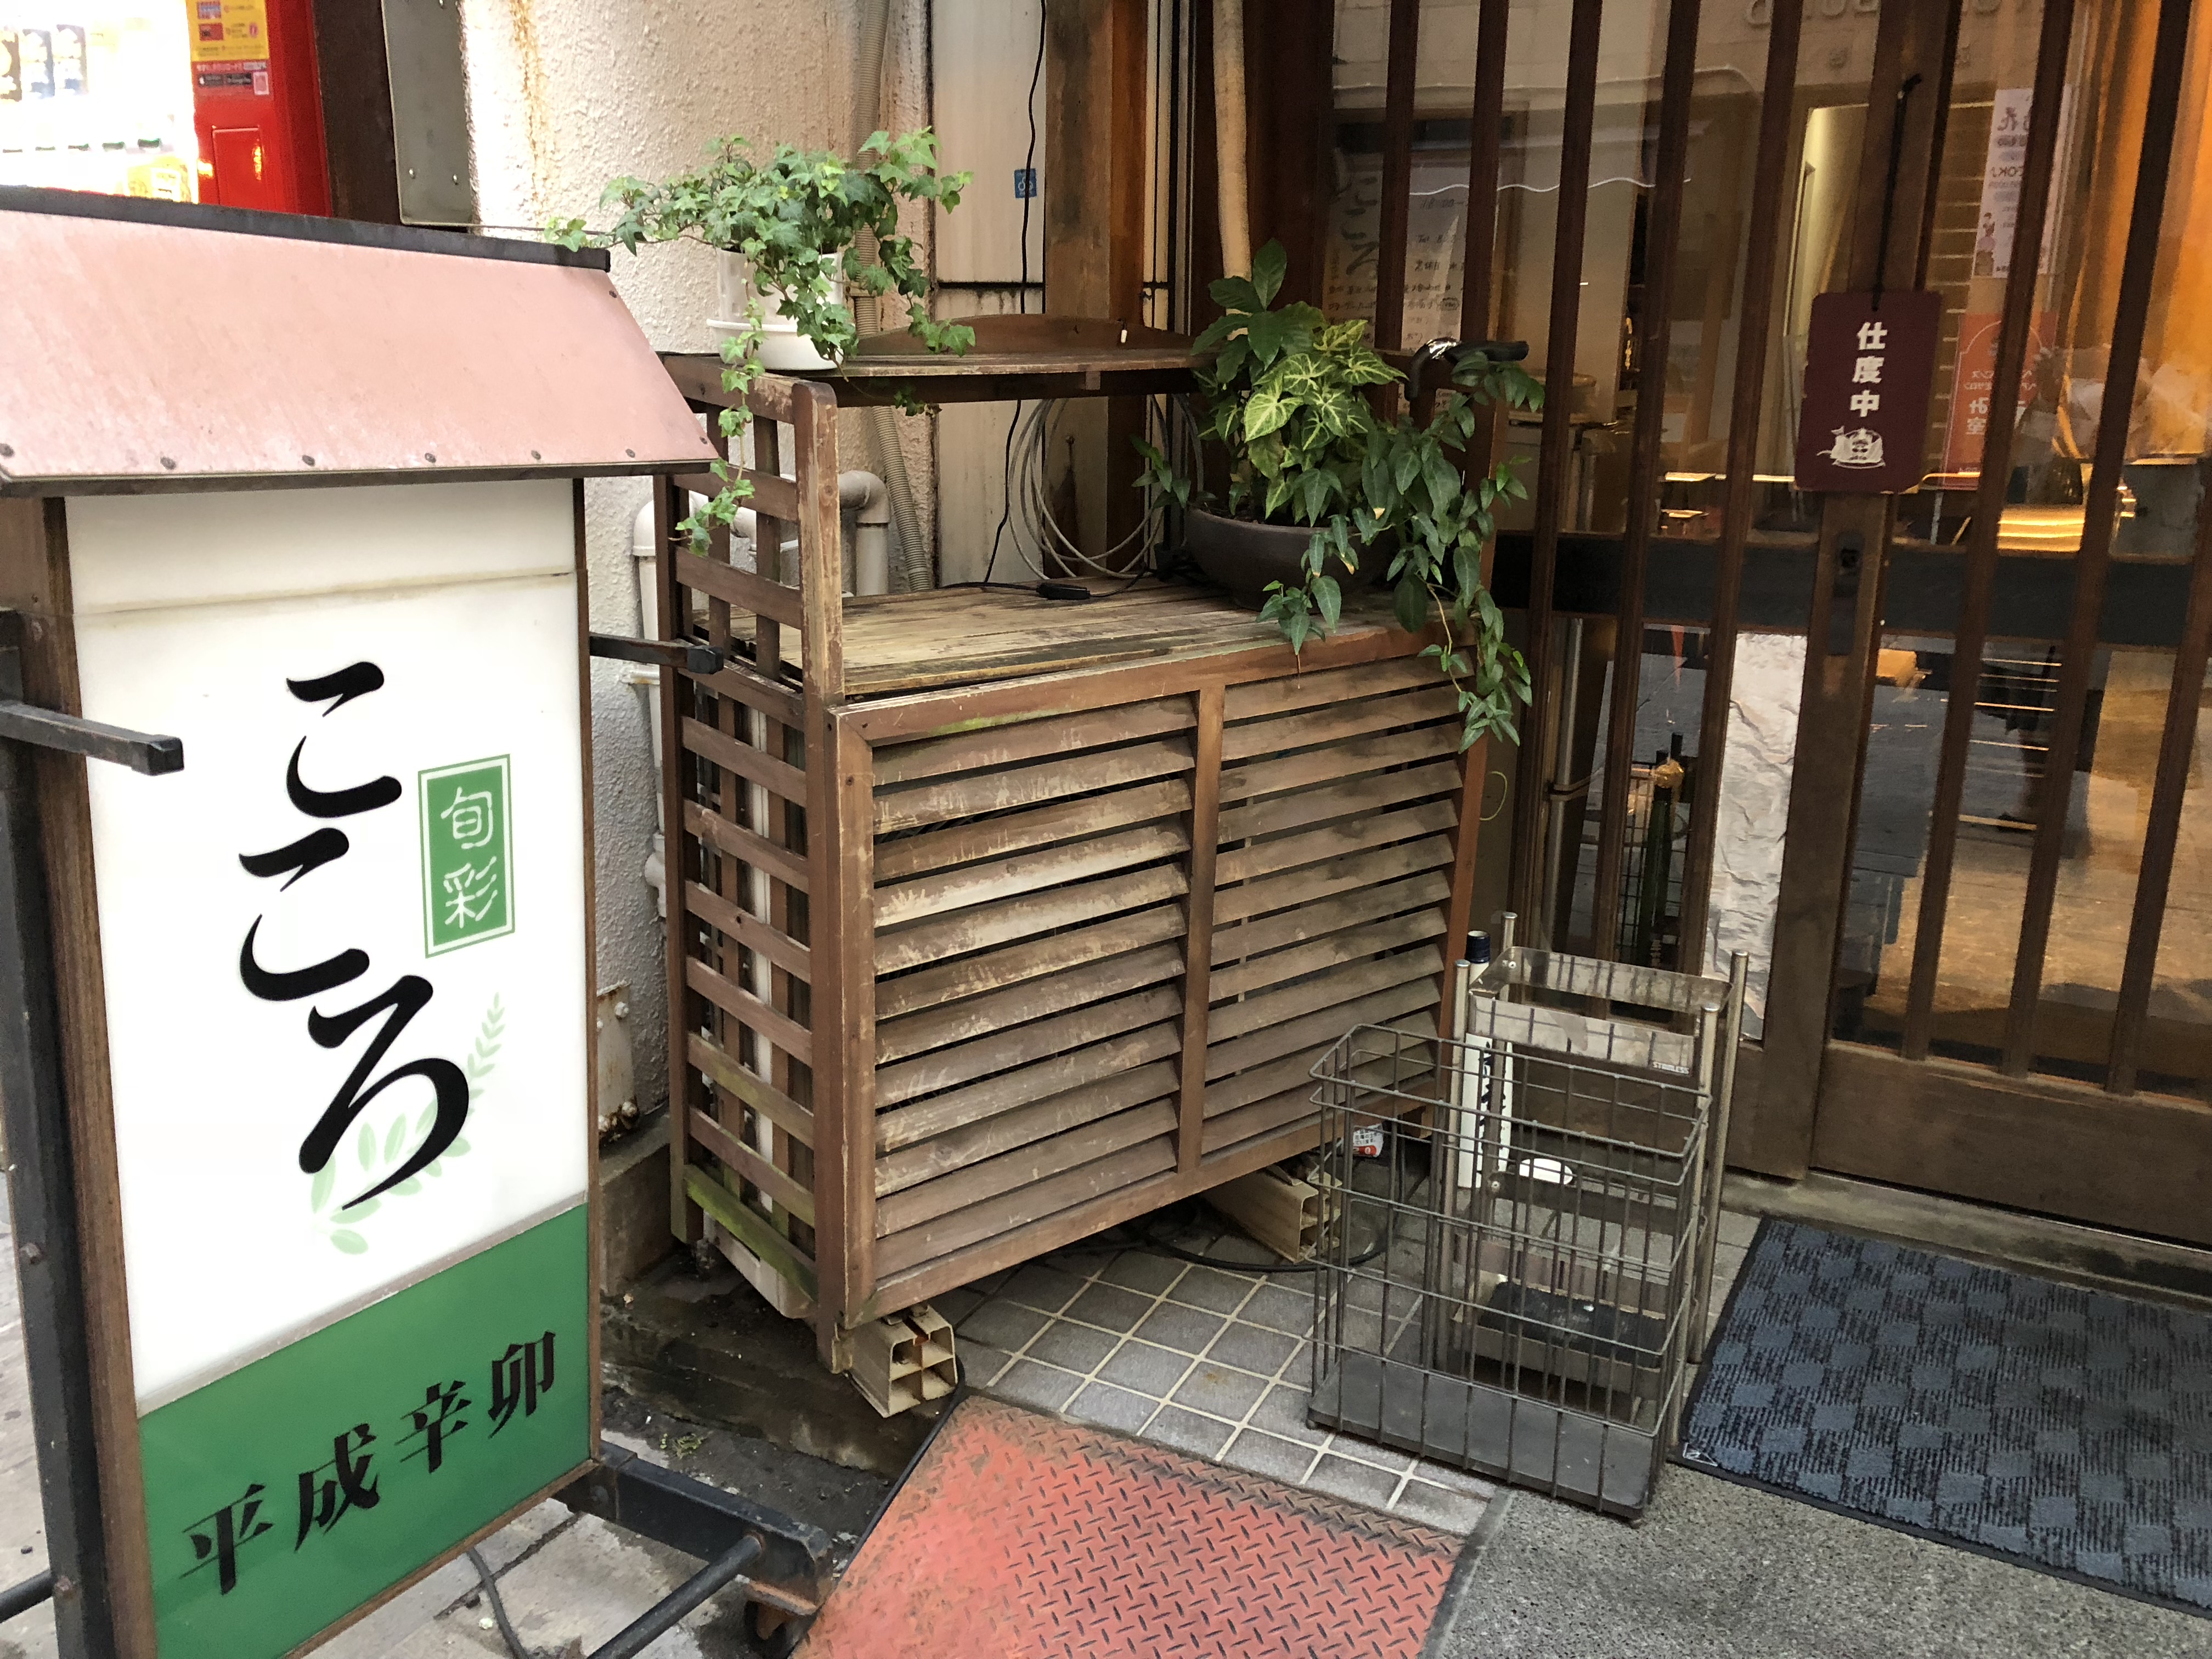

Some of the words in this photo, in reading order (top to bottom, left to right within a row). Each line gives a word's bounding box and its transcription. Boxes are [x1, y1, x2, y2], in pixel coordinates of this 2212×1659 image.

[1850, 321, 1888, 417] 仕度中
[239, 661, 469, 1210] こころ
[441, 786, 498, 929] 旬彩
[178, 1330, 556, 1595] 平成辛卯
